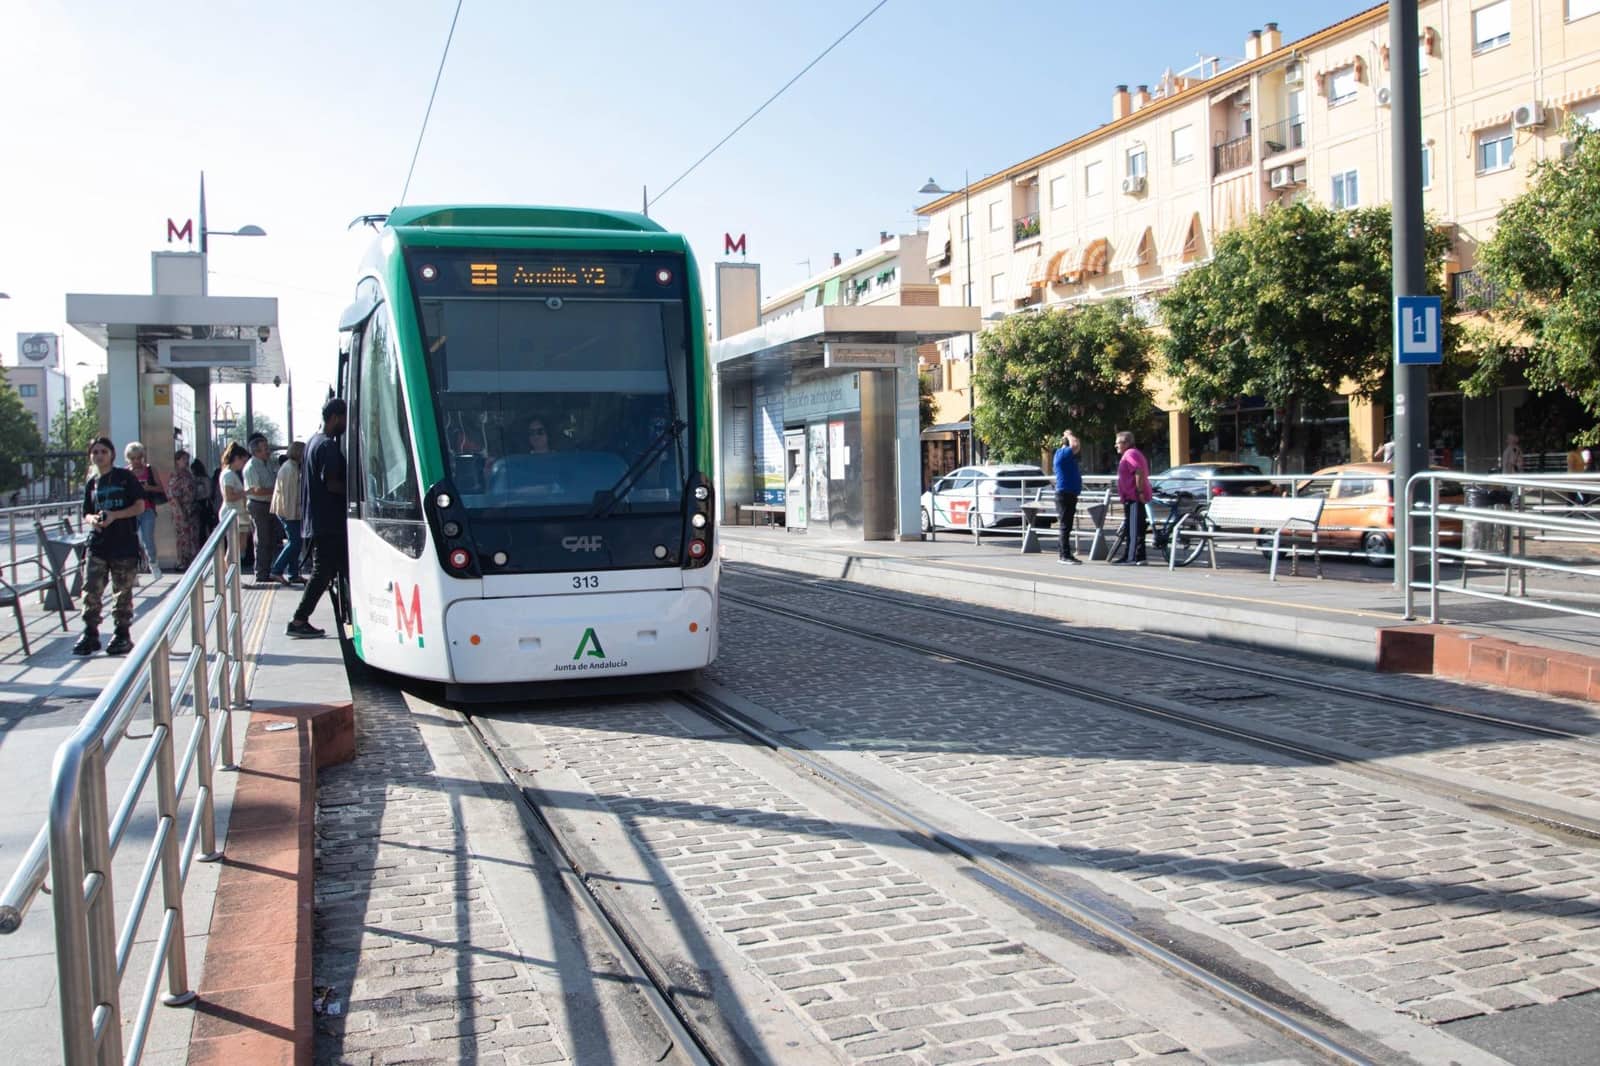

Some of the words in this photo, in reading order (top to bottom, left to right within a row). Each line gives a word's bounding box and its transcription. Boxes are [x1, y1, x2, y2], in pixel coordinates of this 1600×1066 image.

[168, 218, 192, 243] M
[725, 232, 746, 255] M
[1414, 315, 1425, 335] 1
[561, 535, 603, 552] CAF
[572, 575, 599, 588] 313
[394, 581, 424, 648] M
[554, 663, 577, 671] Junta
[578, 662, 588, 670] de
[589, 660, 628, 669] Andalucía
